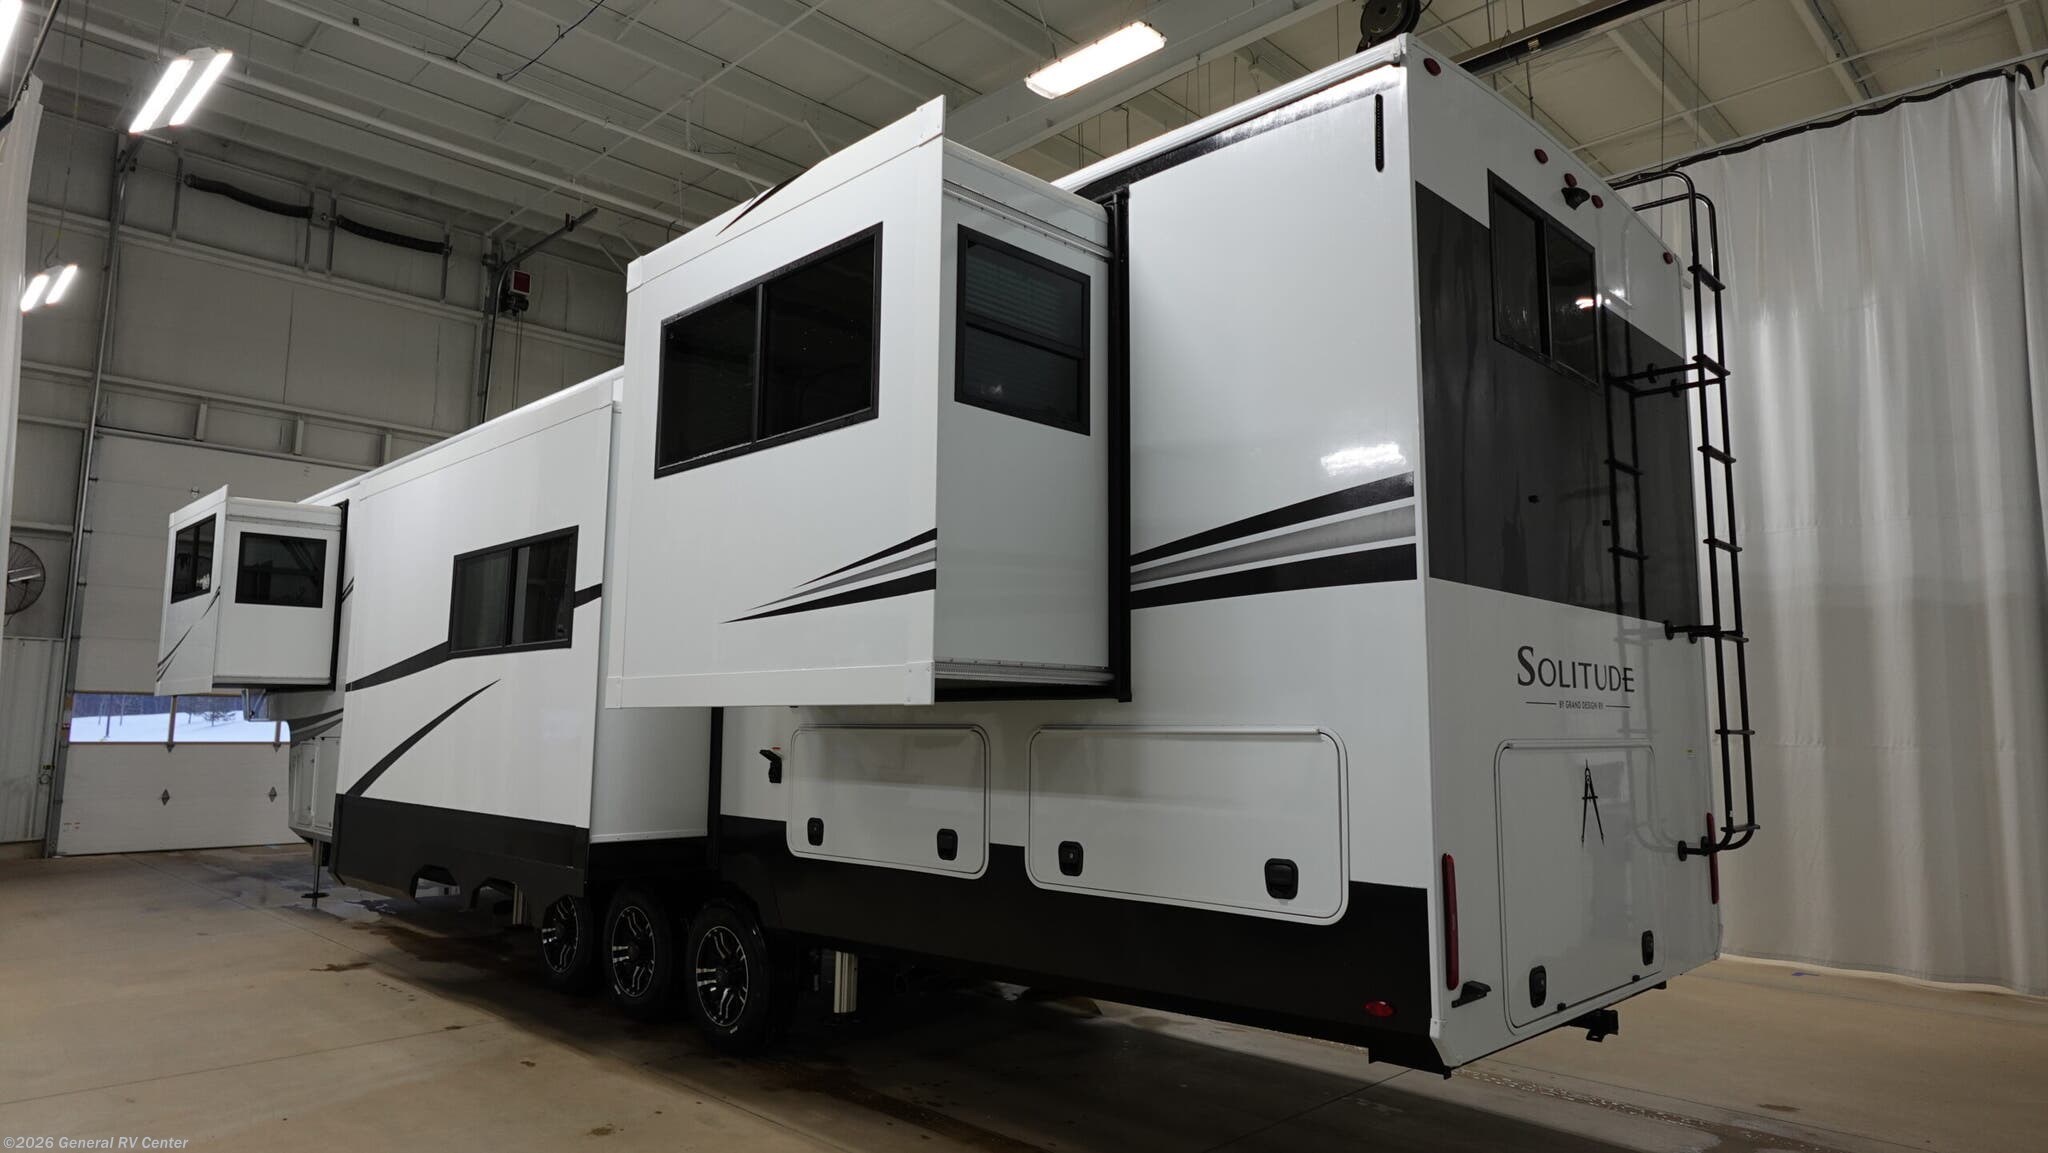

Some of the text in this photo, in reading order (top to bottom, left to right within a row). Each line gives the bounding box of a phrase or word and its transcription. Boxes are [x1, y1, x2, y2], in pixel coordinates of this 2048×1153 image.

[1517, 645, 1635, 692] SOLITUDE
[1559, 700, 1565, 709] BY
[1566, 700, 1581, 710] GRAND
[1582, 701, 1598, 710] DESIGN
